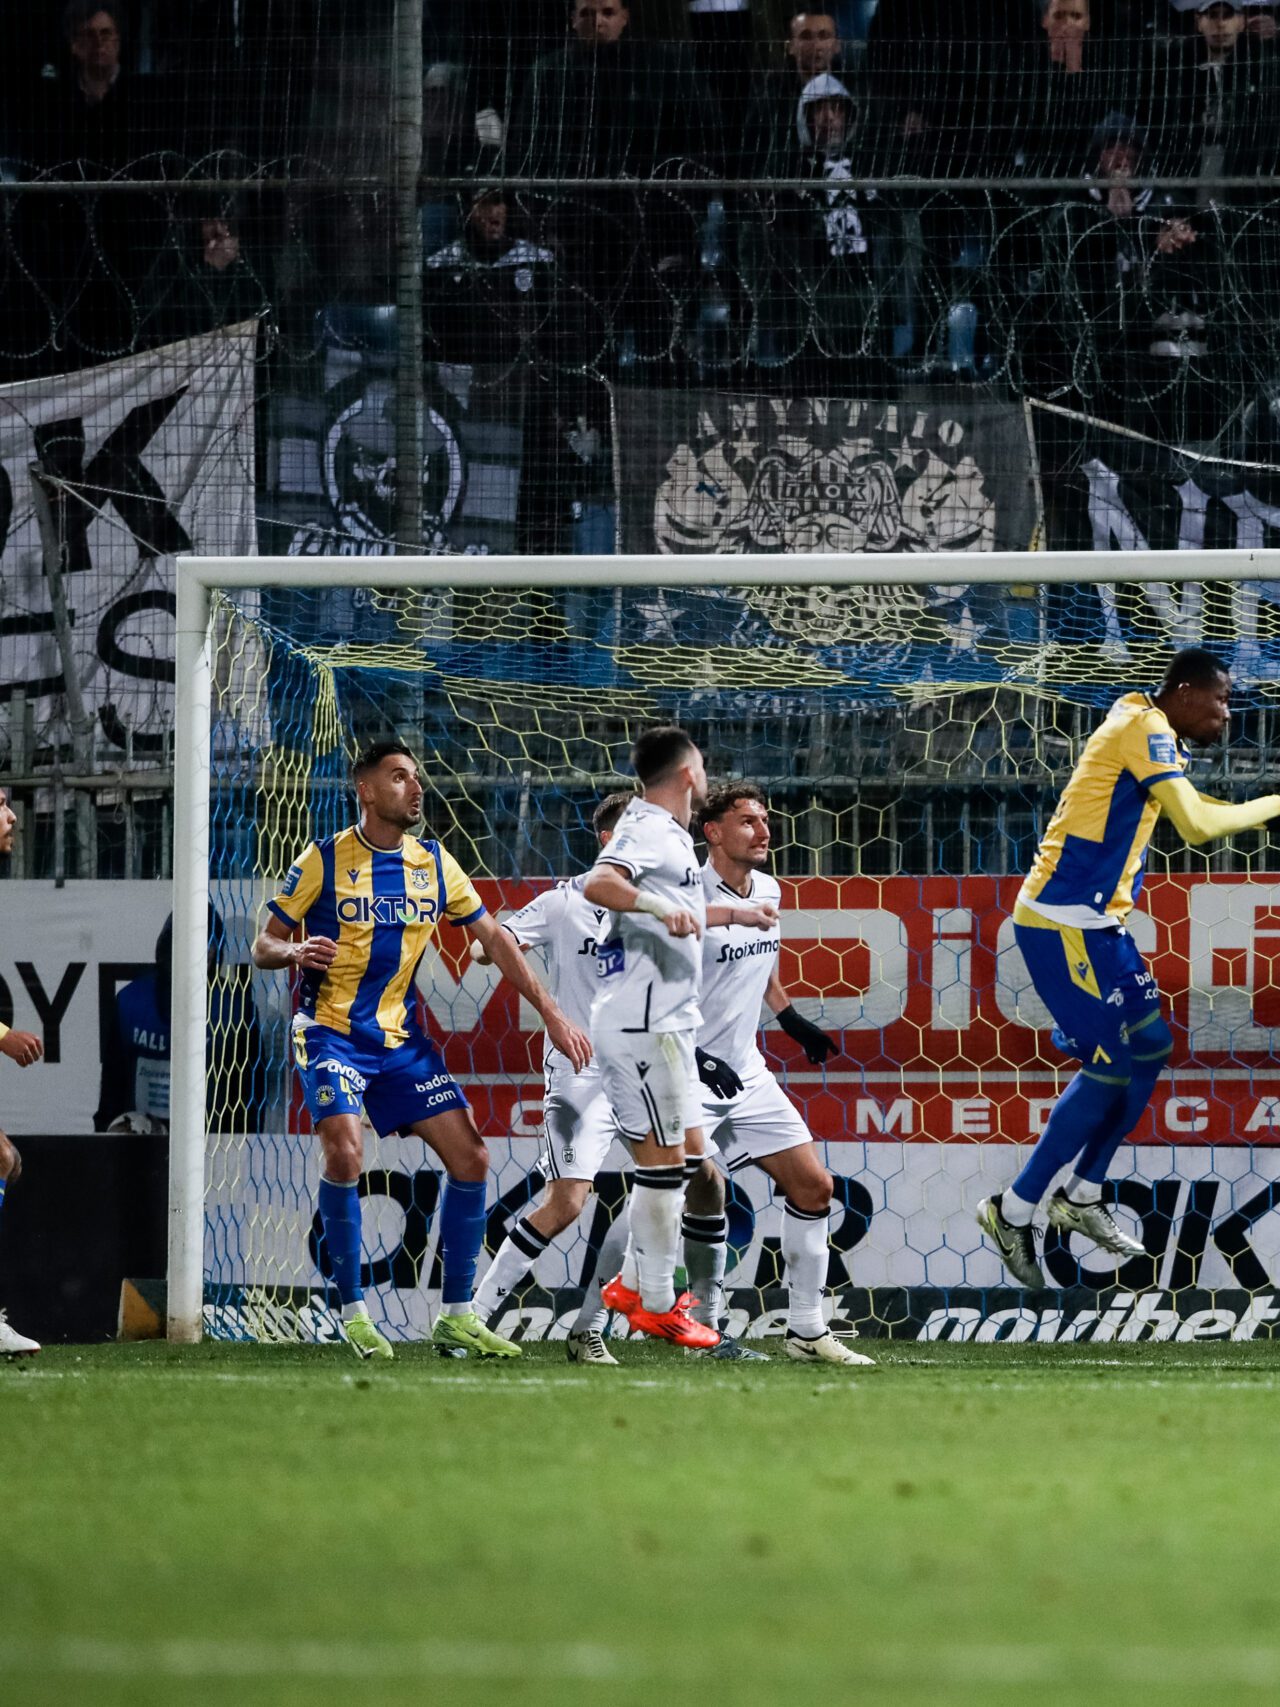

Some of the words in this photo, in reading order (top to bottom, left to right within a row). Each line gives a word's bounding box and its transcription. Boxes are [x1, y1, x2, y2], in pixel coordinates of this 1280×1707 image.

[716, 938, 779, 963] Stoixima
[1144, 986, 1159, 1000] .co
[327, 1060, 367, 1091] avance
[415, 1073, 457, 1094] badou
[426, 1089, 457, 1108] .com
[916, 1293, 1280, 1342] novibet
